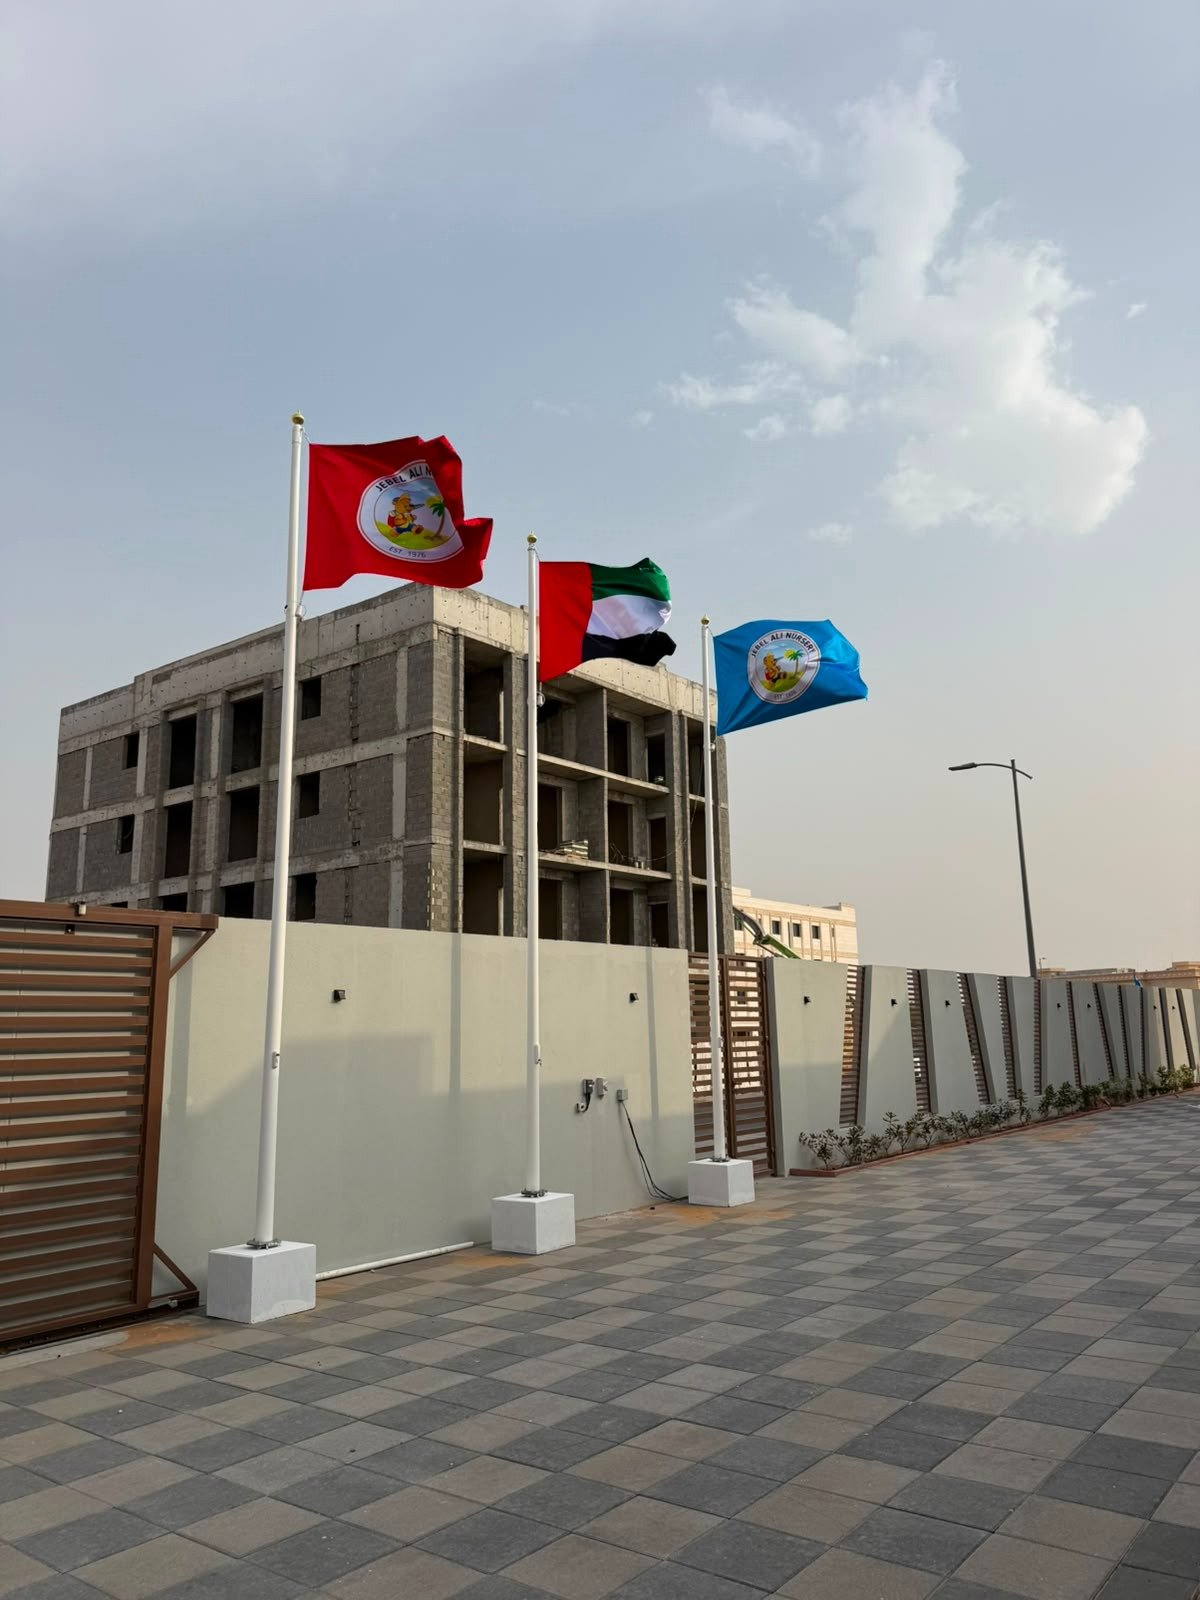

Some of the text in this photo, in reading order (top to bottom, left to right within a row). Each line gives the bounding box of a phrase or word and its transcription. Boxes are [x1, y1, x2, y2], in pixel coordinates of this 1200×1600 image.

[375, 476, 407, 492] JEBEL
[409, 465, 423, 480] ALI
[388, 546, 403, 554] EST
[751, 639, 768, 658] JEBEL
[770, 632, 783, 641] ALI
